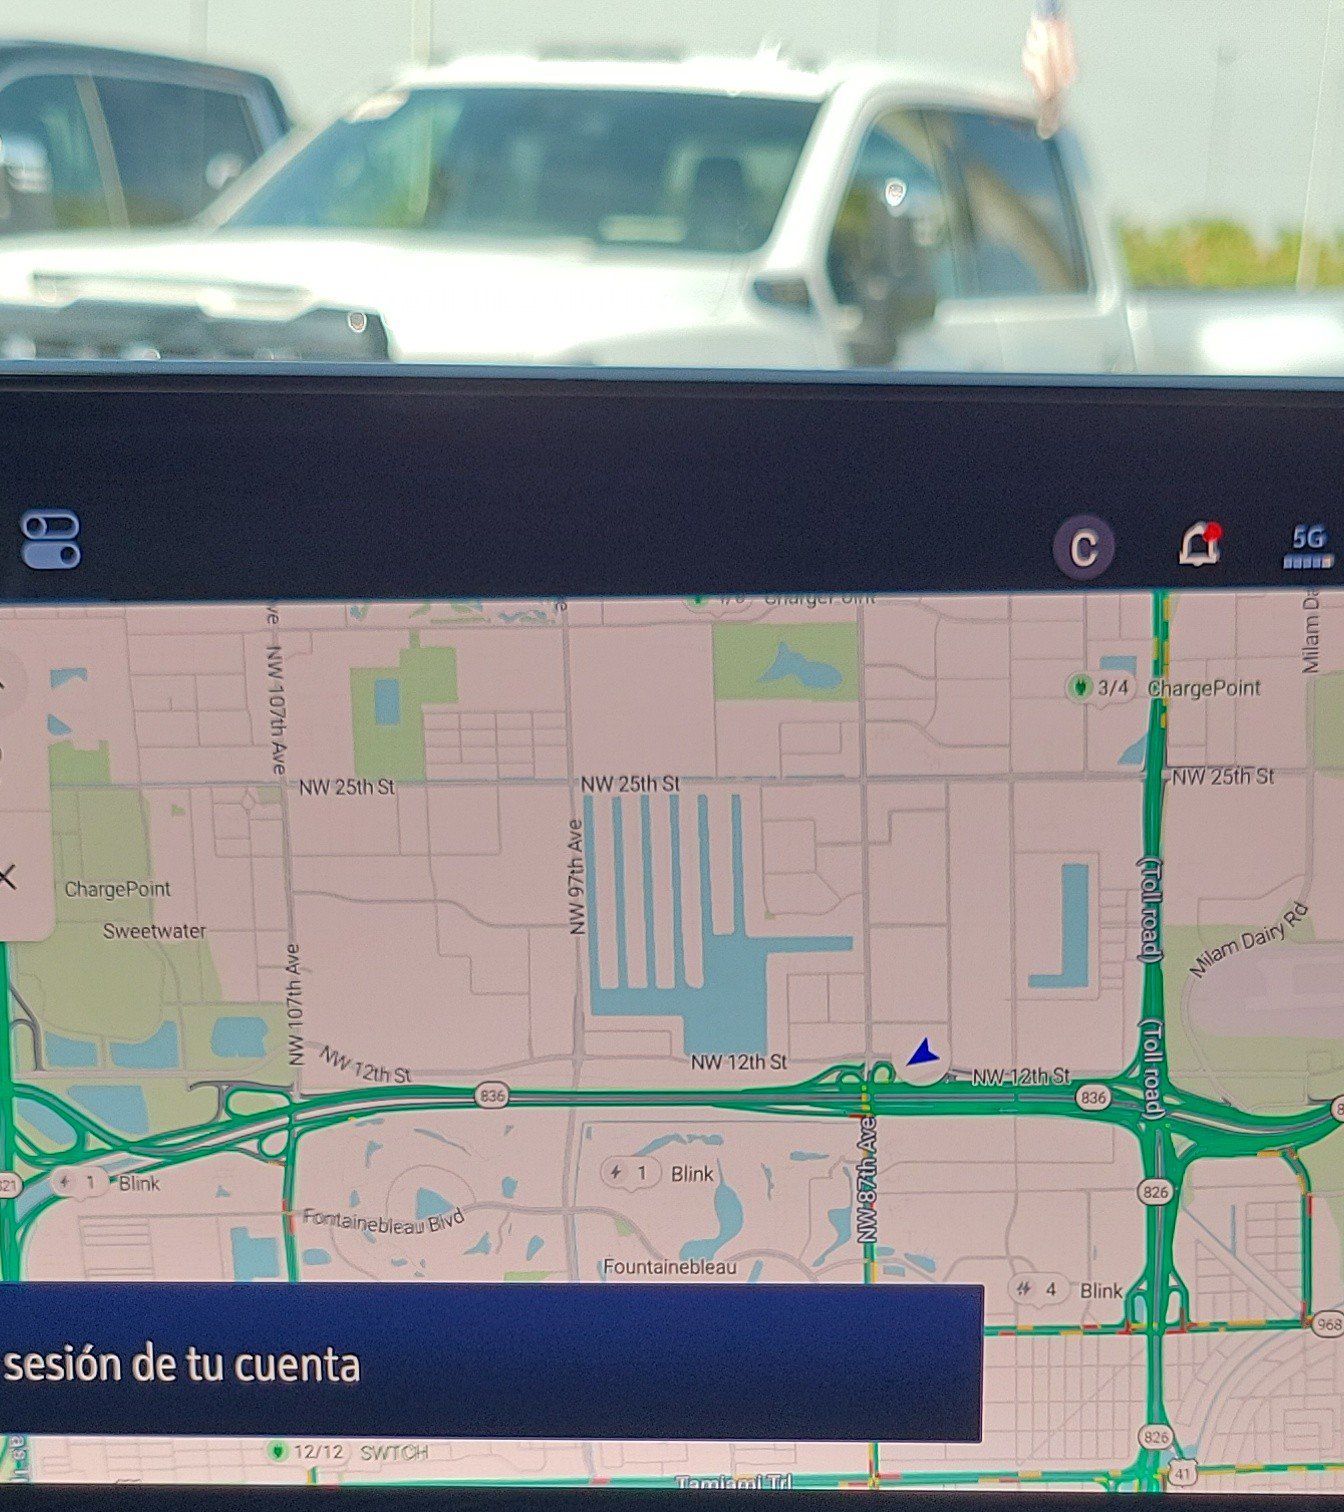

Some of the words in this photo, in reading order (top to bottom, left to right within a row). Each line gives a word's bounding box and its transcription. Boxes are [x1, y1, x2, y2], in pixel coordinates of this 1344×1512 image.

[1071, 530, 1098, 567] C
[1293, 526, 1325, 548] 5G
[1302, 614, 1319, 674] Milam
[266, 646, 283, 679] NW
[1097, 680, 1129, 696] 3/4
[1147, 679, 1261, 701] ChargePoint
[269, 685, 287, 736] 107th
[272, 741, 287, 775] Ave
[299, 778, 330, 796] NW
[335, 778, 373, 796] 25th
[376, 778, 396, 796] St
[581, 776, 613, 793] NW
[618, 775, 657, 793] 25th
[662, 775, 681, 792] St
[1171, 768, 1206, 785] NW
[1211, 767, 1251, 785] 25th
[1256, 767, 1276, 785] St
[568, 819, 582, 855] Ave
[65, 880, 171, 899] ChargePoint
[569, 859, 583, 901] 97th
[1135, 857, 1163, 903] (Toll
[103, 921, 206, 940] Sweetwater
[570, 904, 584, 935] NW
[1137, 909, 1164, 963] road)
[1189, 941, 1239, 979] Milam
[1241, 923, 1286, 949] Dairy
[1283, 900, 1308, 927] Rd
[285, 943, 301, 975] Ave
[285, 980, 303, 1029] 107th
[288, 1035, 305, 1066] NW
[1137, 1019, 1164, 1062] (Toll
[320, 1044, 351, 1073] NW
[356, 1060, 390, 1083] 12th
[393, 1066, 412, 1084] St
[691, 1053, 724, 1070] NW
[728, 1053, 767, 1071] 12th
[770, 1053, 788, 1070] St
[973, 1068, 1004, 1086] NW
[1009, 1067, 1048, 1085] 12th
[1051, 1066, 1071, 1085] St
[480, 1089, 506, 1103] 836
[1081, 1091, 1107, 1105] 836
[1142, 1068, 1166, 1120] road)
[858, 1116, 877, 1154] Ave
[87, 1175, 94, 1189] 1
[119, 1174, 161, 1192] Blink
[638, 1165, 646, 1180] 1
[672, 1165, 714, 1183] Blink
[857, 1157, 877, 1206] 87th
[1143, 1185, 1169, 1199] 826
[303, 1207, 425, 1235] Fontainebleau
[428, 1206, 465, 1232] Blvd
[857, 1208, 878, 1243] NW
[603, 1258, 737, 1276] Fountainebleau
[1046, 1282, 1056, 1296] 4
[1080, 1281, 1123, 1299] Blink
[1317, 1317, 1343, 1332] 968
[3, 1340, 121, 1382] sesión
[132, 1340, 176, 1383] de
[186, 1343, 224, 1383] tu
[235, 1348, 361, 1384] cuenta
[294, 1444, 343, 1460] 12/12
[360, 1444, 429, 1461] SWTCH
[1144, 1431, 1170, 1444] 826
[1175, 1468, 1190, 1480] 41
